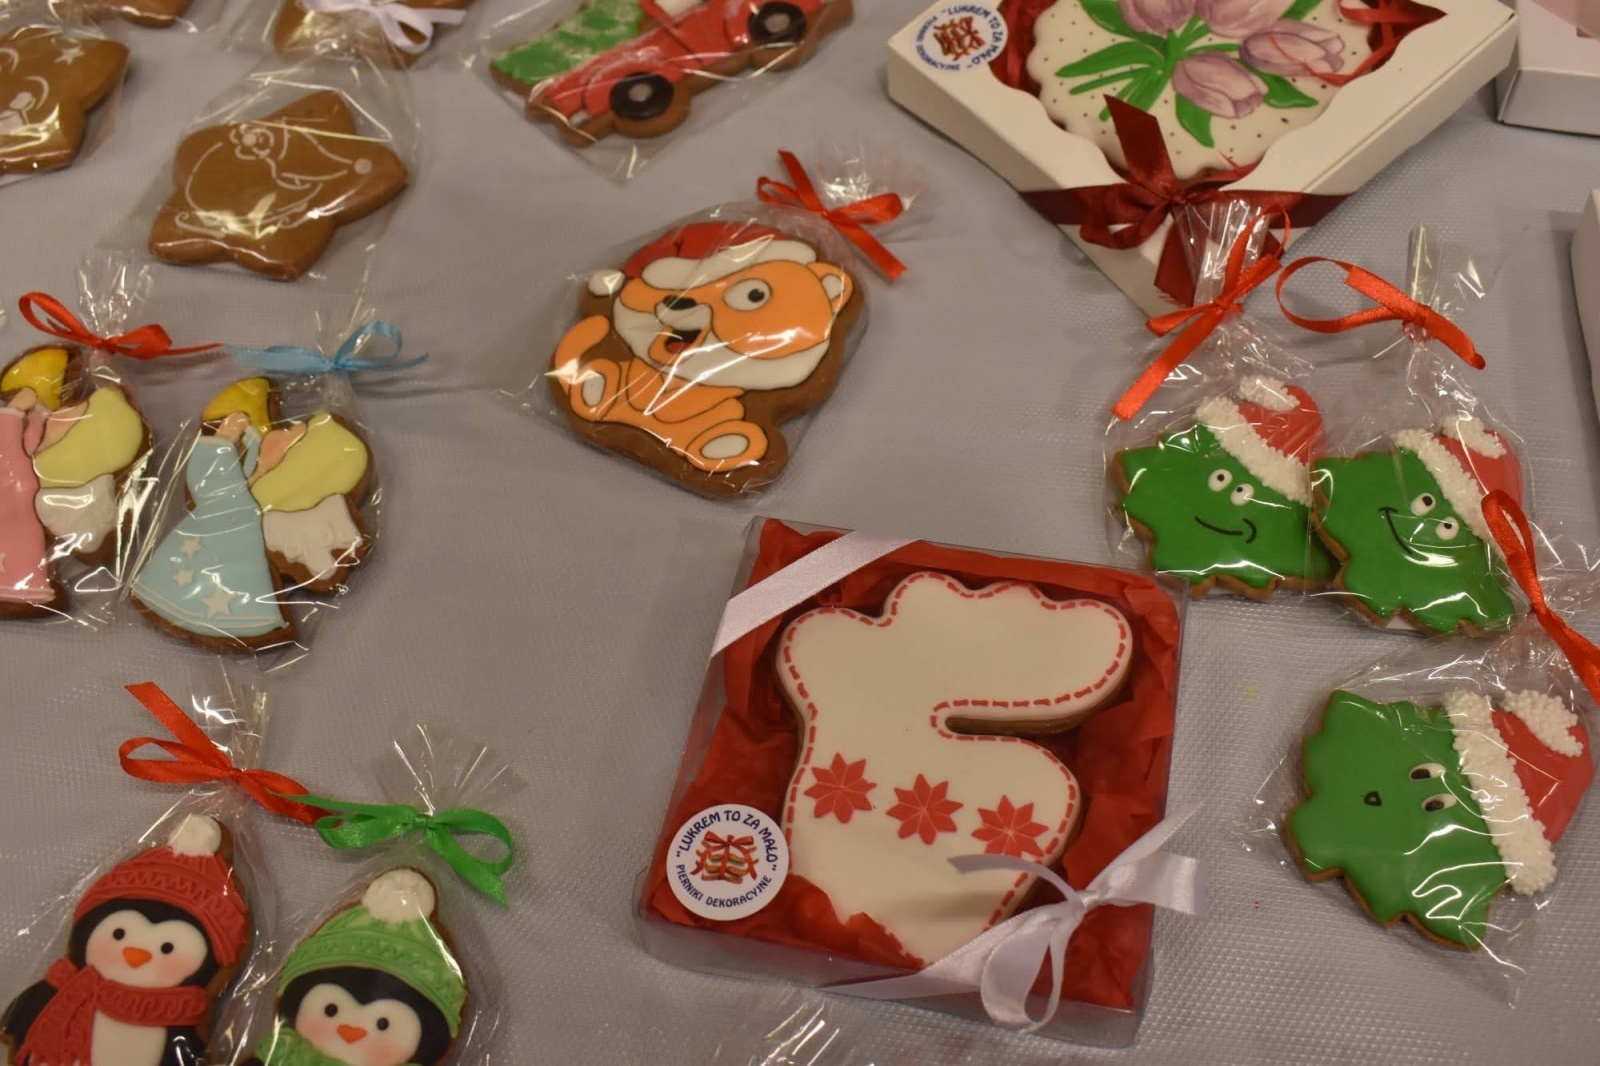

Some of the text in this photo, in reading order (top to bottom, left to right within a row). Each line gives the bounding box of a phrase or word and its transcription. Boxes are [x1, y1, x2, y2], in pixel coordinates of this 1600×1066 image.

[989, 16, 1001, 29] TO
[993, 31, 1003, 43] ZA
[676, 812, 721, 858] "LUKREM
[724, 810, 741, 822] TO
[743, 814, 761, 830] ZA
[676, 865, 772, 908] PIERNIKI DEKORACYJNE
